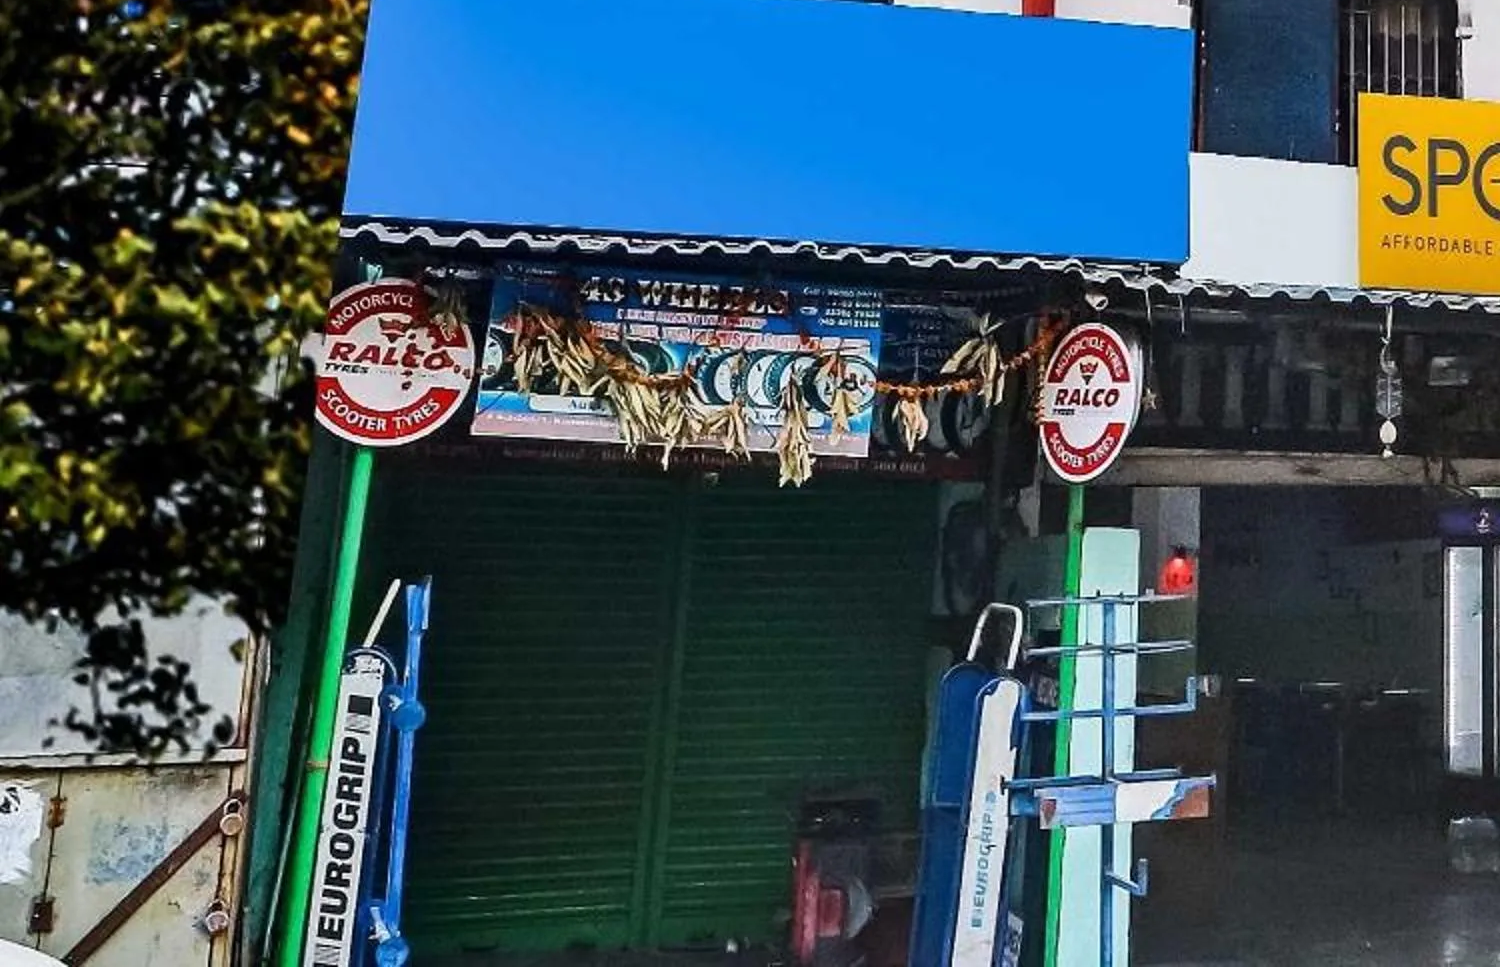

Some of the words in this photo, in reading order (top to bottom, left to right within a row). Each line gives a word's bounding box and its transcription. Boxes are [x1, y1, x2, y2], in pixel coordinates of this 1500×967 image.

[1381, 235, 1493, 256] AFFORDABLE
[331, 292, 414, 330] MOTORCYCL
[324, 362, 371, 375] TYRES
[1055, 336, 1105, 378] MOTORCYCLE
[321, 388, 387, 432] SCOOTER
[391, 398, 441, 430] TYRES
[1053, 388, 1120, 408] RALCO
[1049, 433, 1084, 467] SCOOTER
[1087, 435, 1115, 466] TYRES
[317, 735, 370, 942] EUROGRIP
